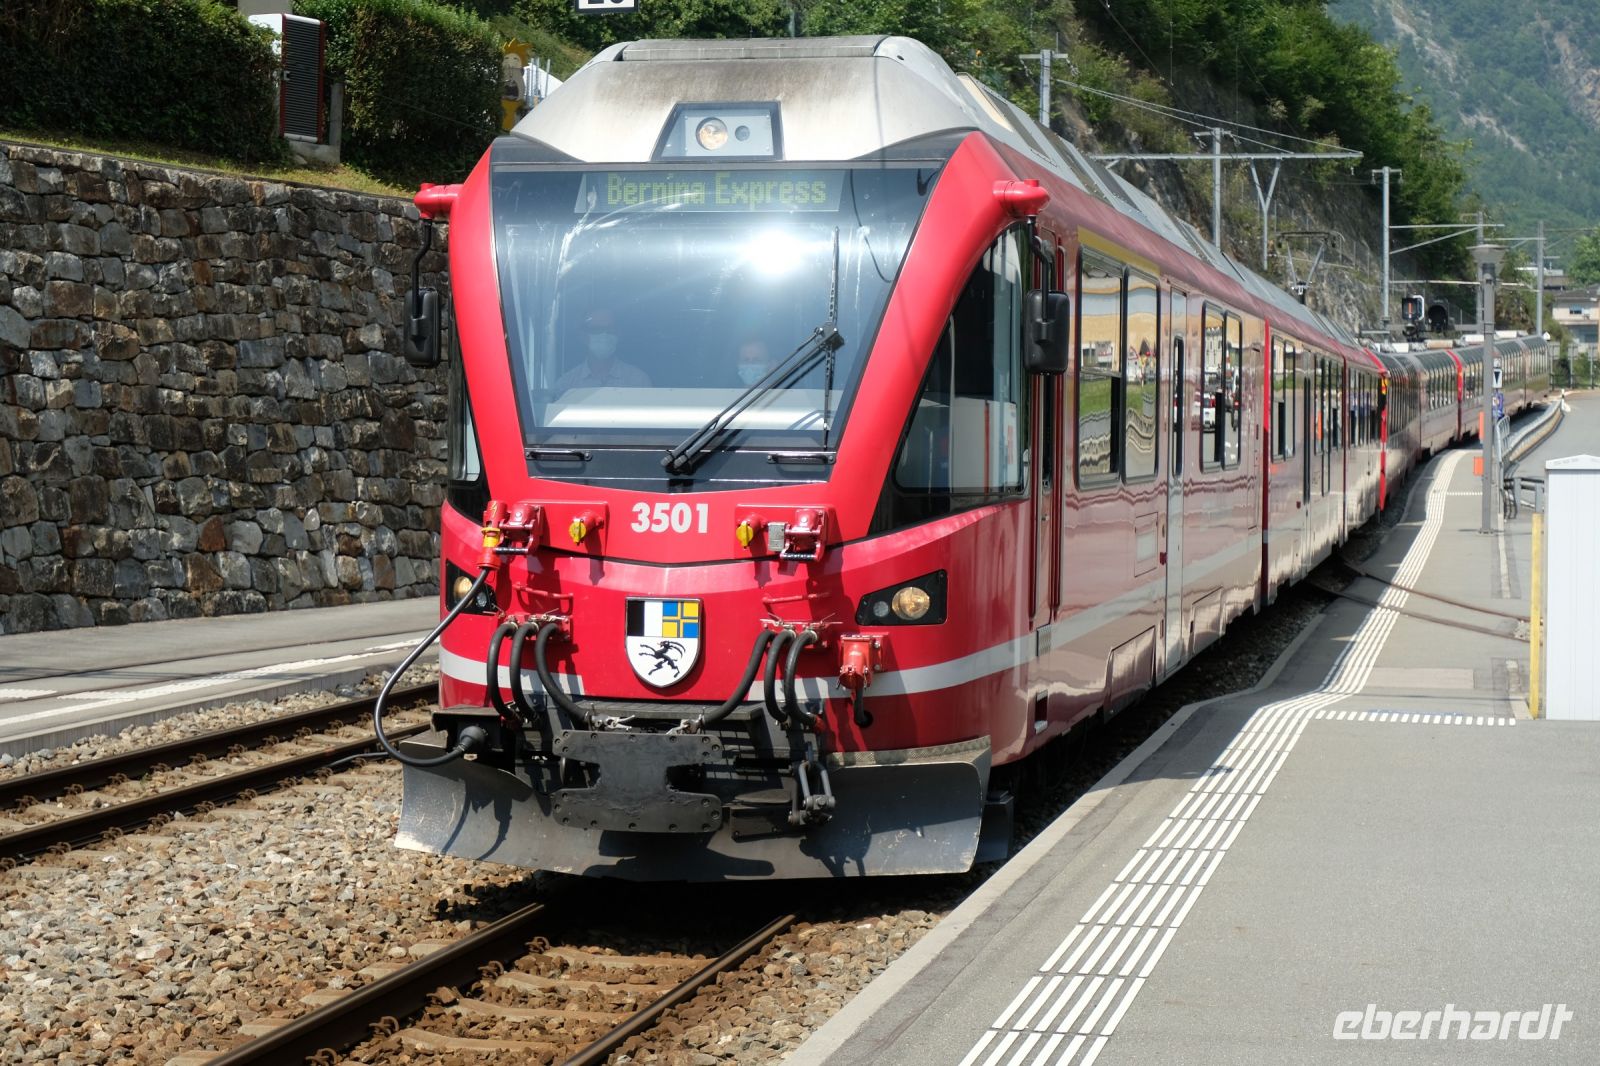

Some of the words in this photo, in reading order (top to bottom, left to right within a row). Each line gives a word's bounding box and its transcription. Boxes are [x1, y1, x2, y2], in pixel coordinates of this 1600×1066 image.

[607, 173, 705, 205] Bernina
[715, 172, 826, 210] Express
[631, 502, 709, 533] 3501
